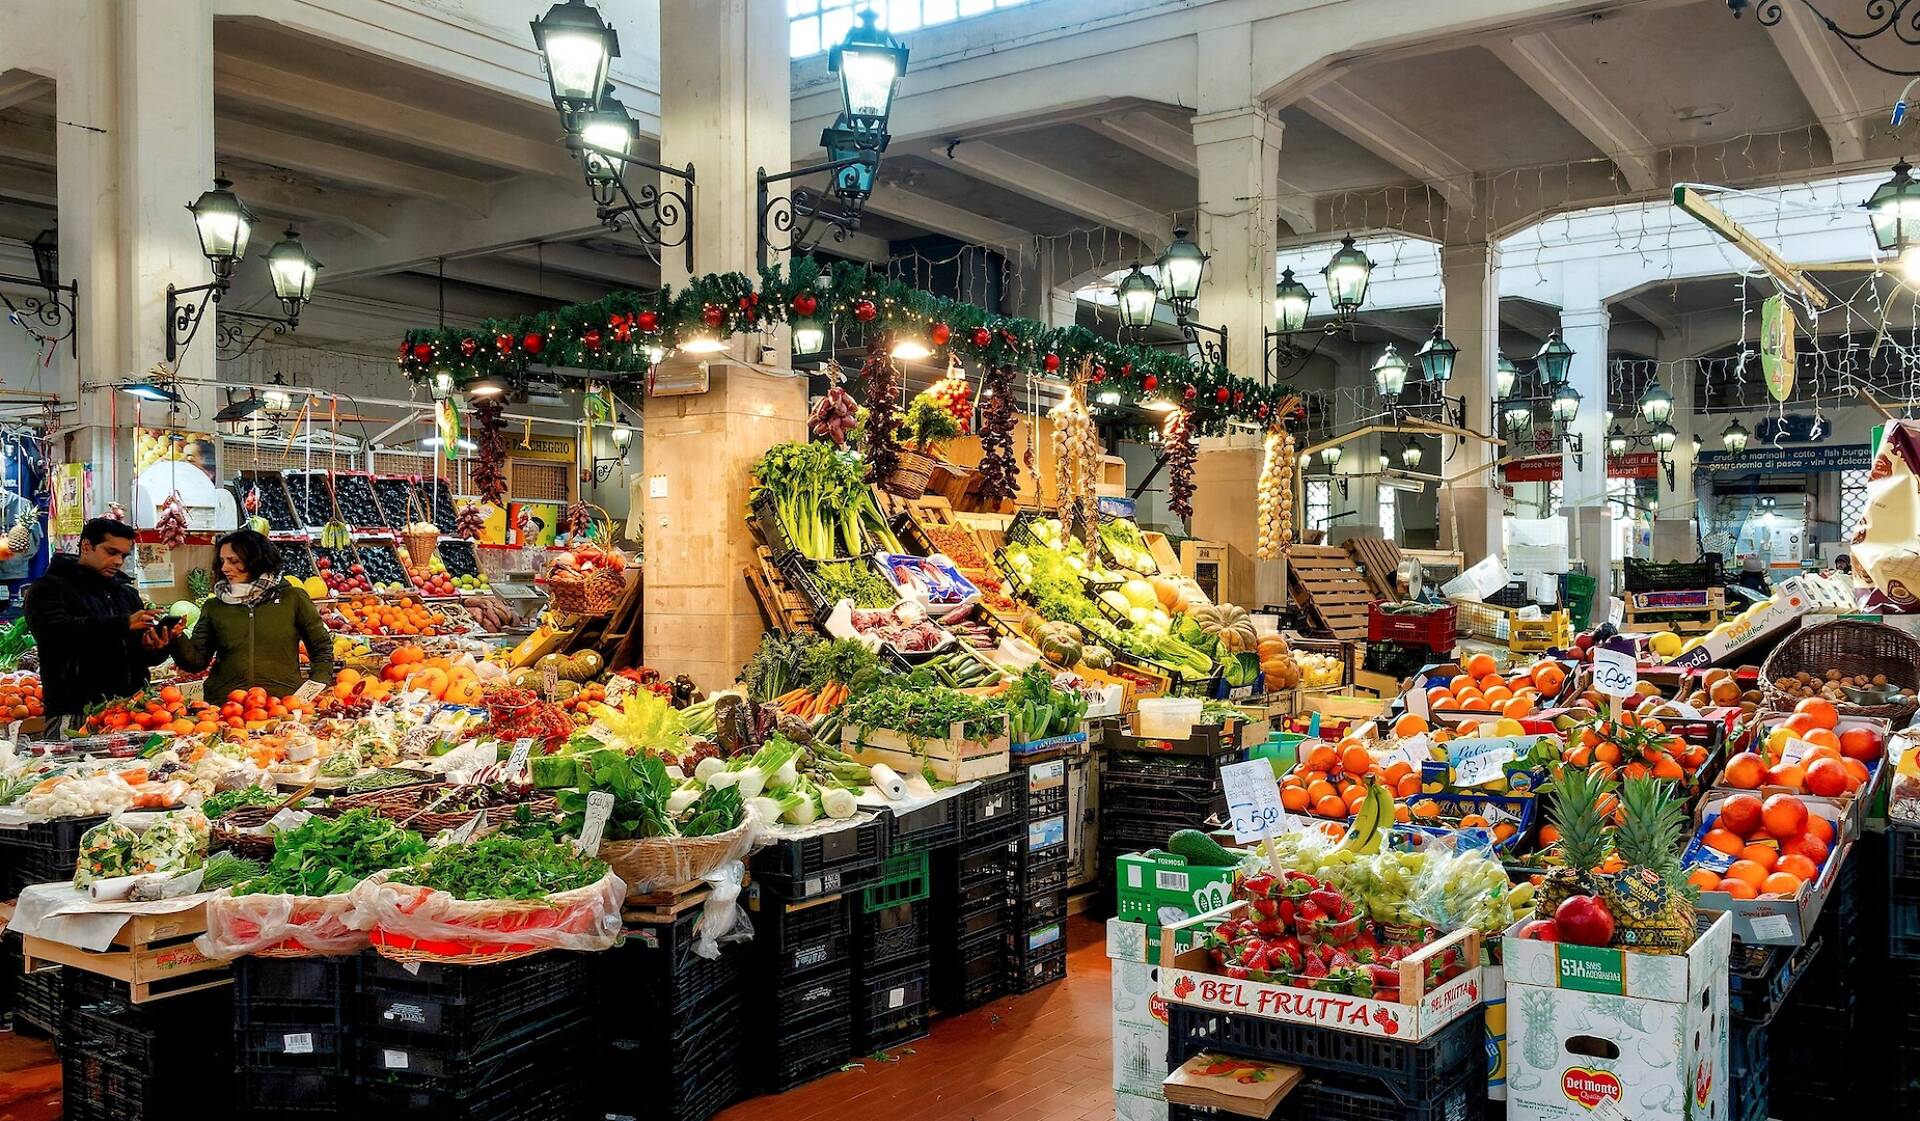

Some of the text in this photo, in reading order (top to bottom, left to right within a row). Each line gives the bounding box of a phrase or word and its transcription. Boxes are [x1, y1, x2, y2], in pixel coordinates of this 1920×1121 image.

[512, 439, 570, 454] PACHEGGIO
[1157, 857, 1185, 867] FORMOSA
[1561, 958, 1586, 978] YES
[1199, 979, 1370, 1027] BEL FRUTTA
[1566, 1077, 1618, 1095] Del Monte
